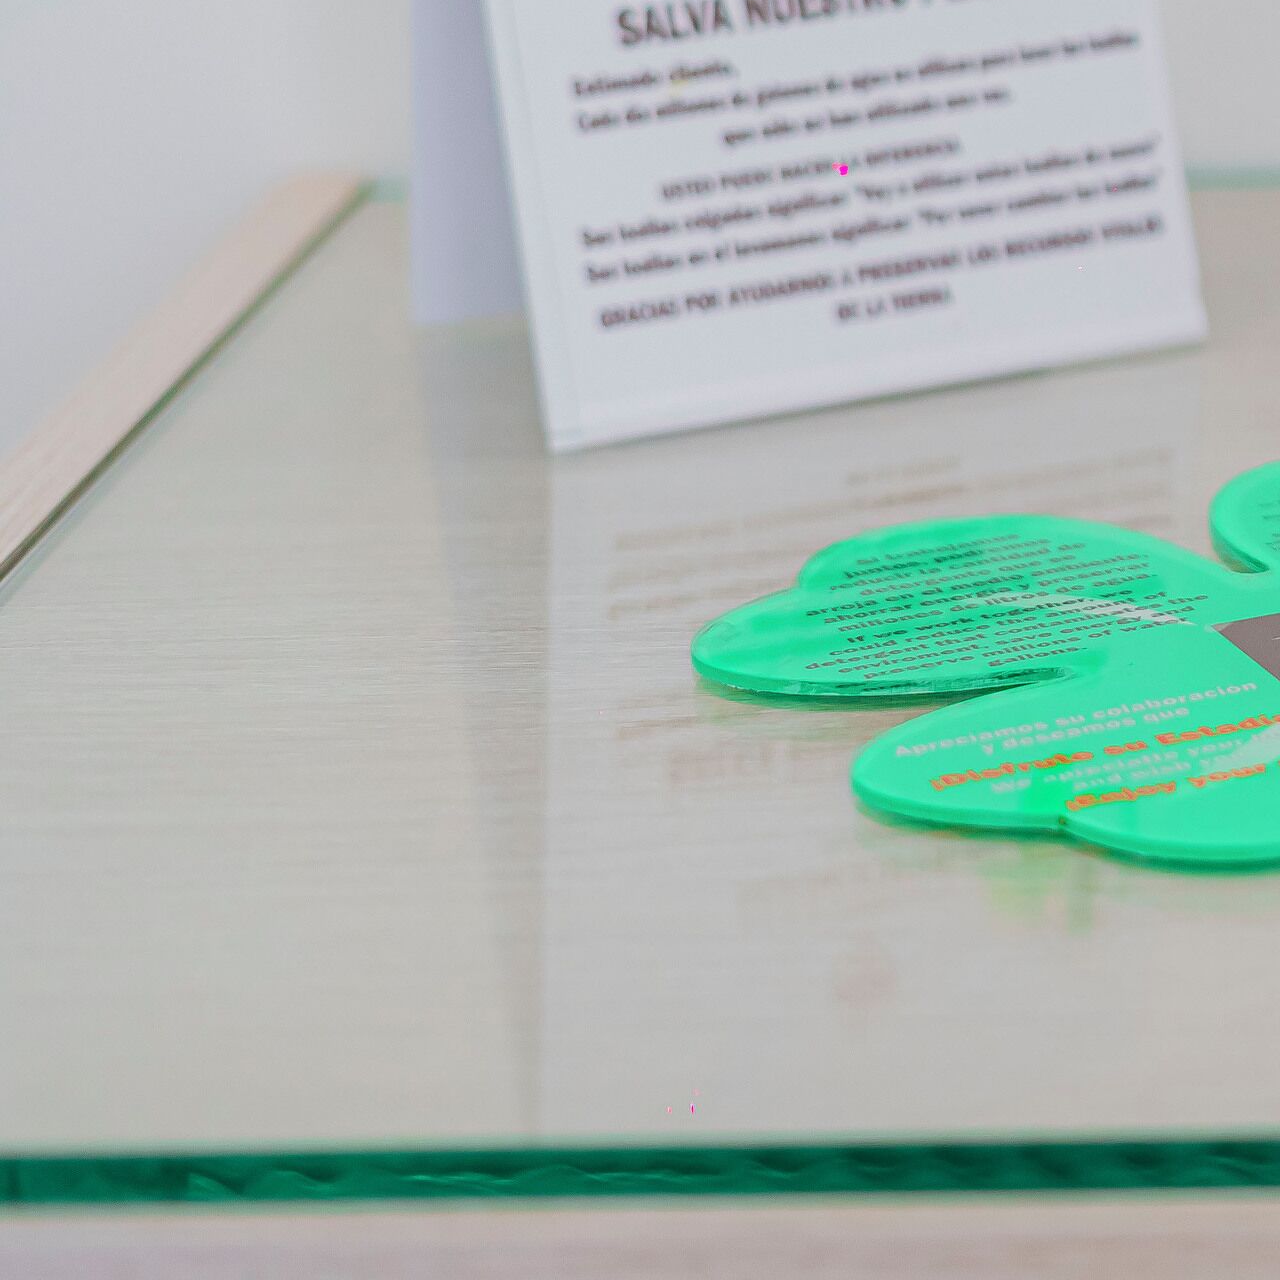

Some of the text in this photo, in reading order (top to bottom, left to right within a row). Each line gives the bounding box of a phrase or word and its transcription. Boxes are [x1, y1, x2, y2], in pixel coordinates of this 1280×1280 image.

[837, 609, 945, 632] millones
[950, 602, 981, 613] de
[984, 591, 1050, 607] litros
[1056, 584, 1086, 595] de
[885, 593, 915, 602] en
[950, 574, 1025, 591] medio
[805, 642, 929, 670] detergent
[935, 633, 986, 646] that
[1167, 594, 1209, 606] the
[824, 603, 913, 624] ahorrar
[829, 591, 1167, 656] could reduce the amount of
[914, 616, 976, 631] work
[995, 632, 1053, 646] save
[1151, 605, 1195, 619] and
[863, 654, 976, 680] preserve
[982, 636, 1082, 658] millions
[1088, 628, 1113, 639] of
[896, 720, 1050, 757] Apreciamos
[1055, 714, 1087, 728] su
[1001, 717, 1138, 751] deseamos
[1142, 705, 1191, 725] que
[1103, 740, 1148, 756] su
[1186, 762, 1268, 790] your
